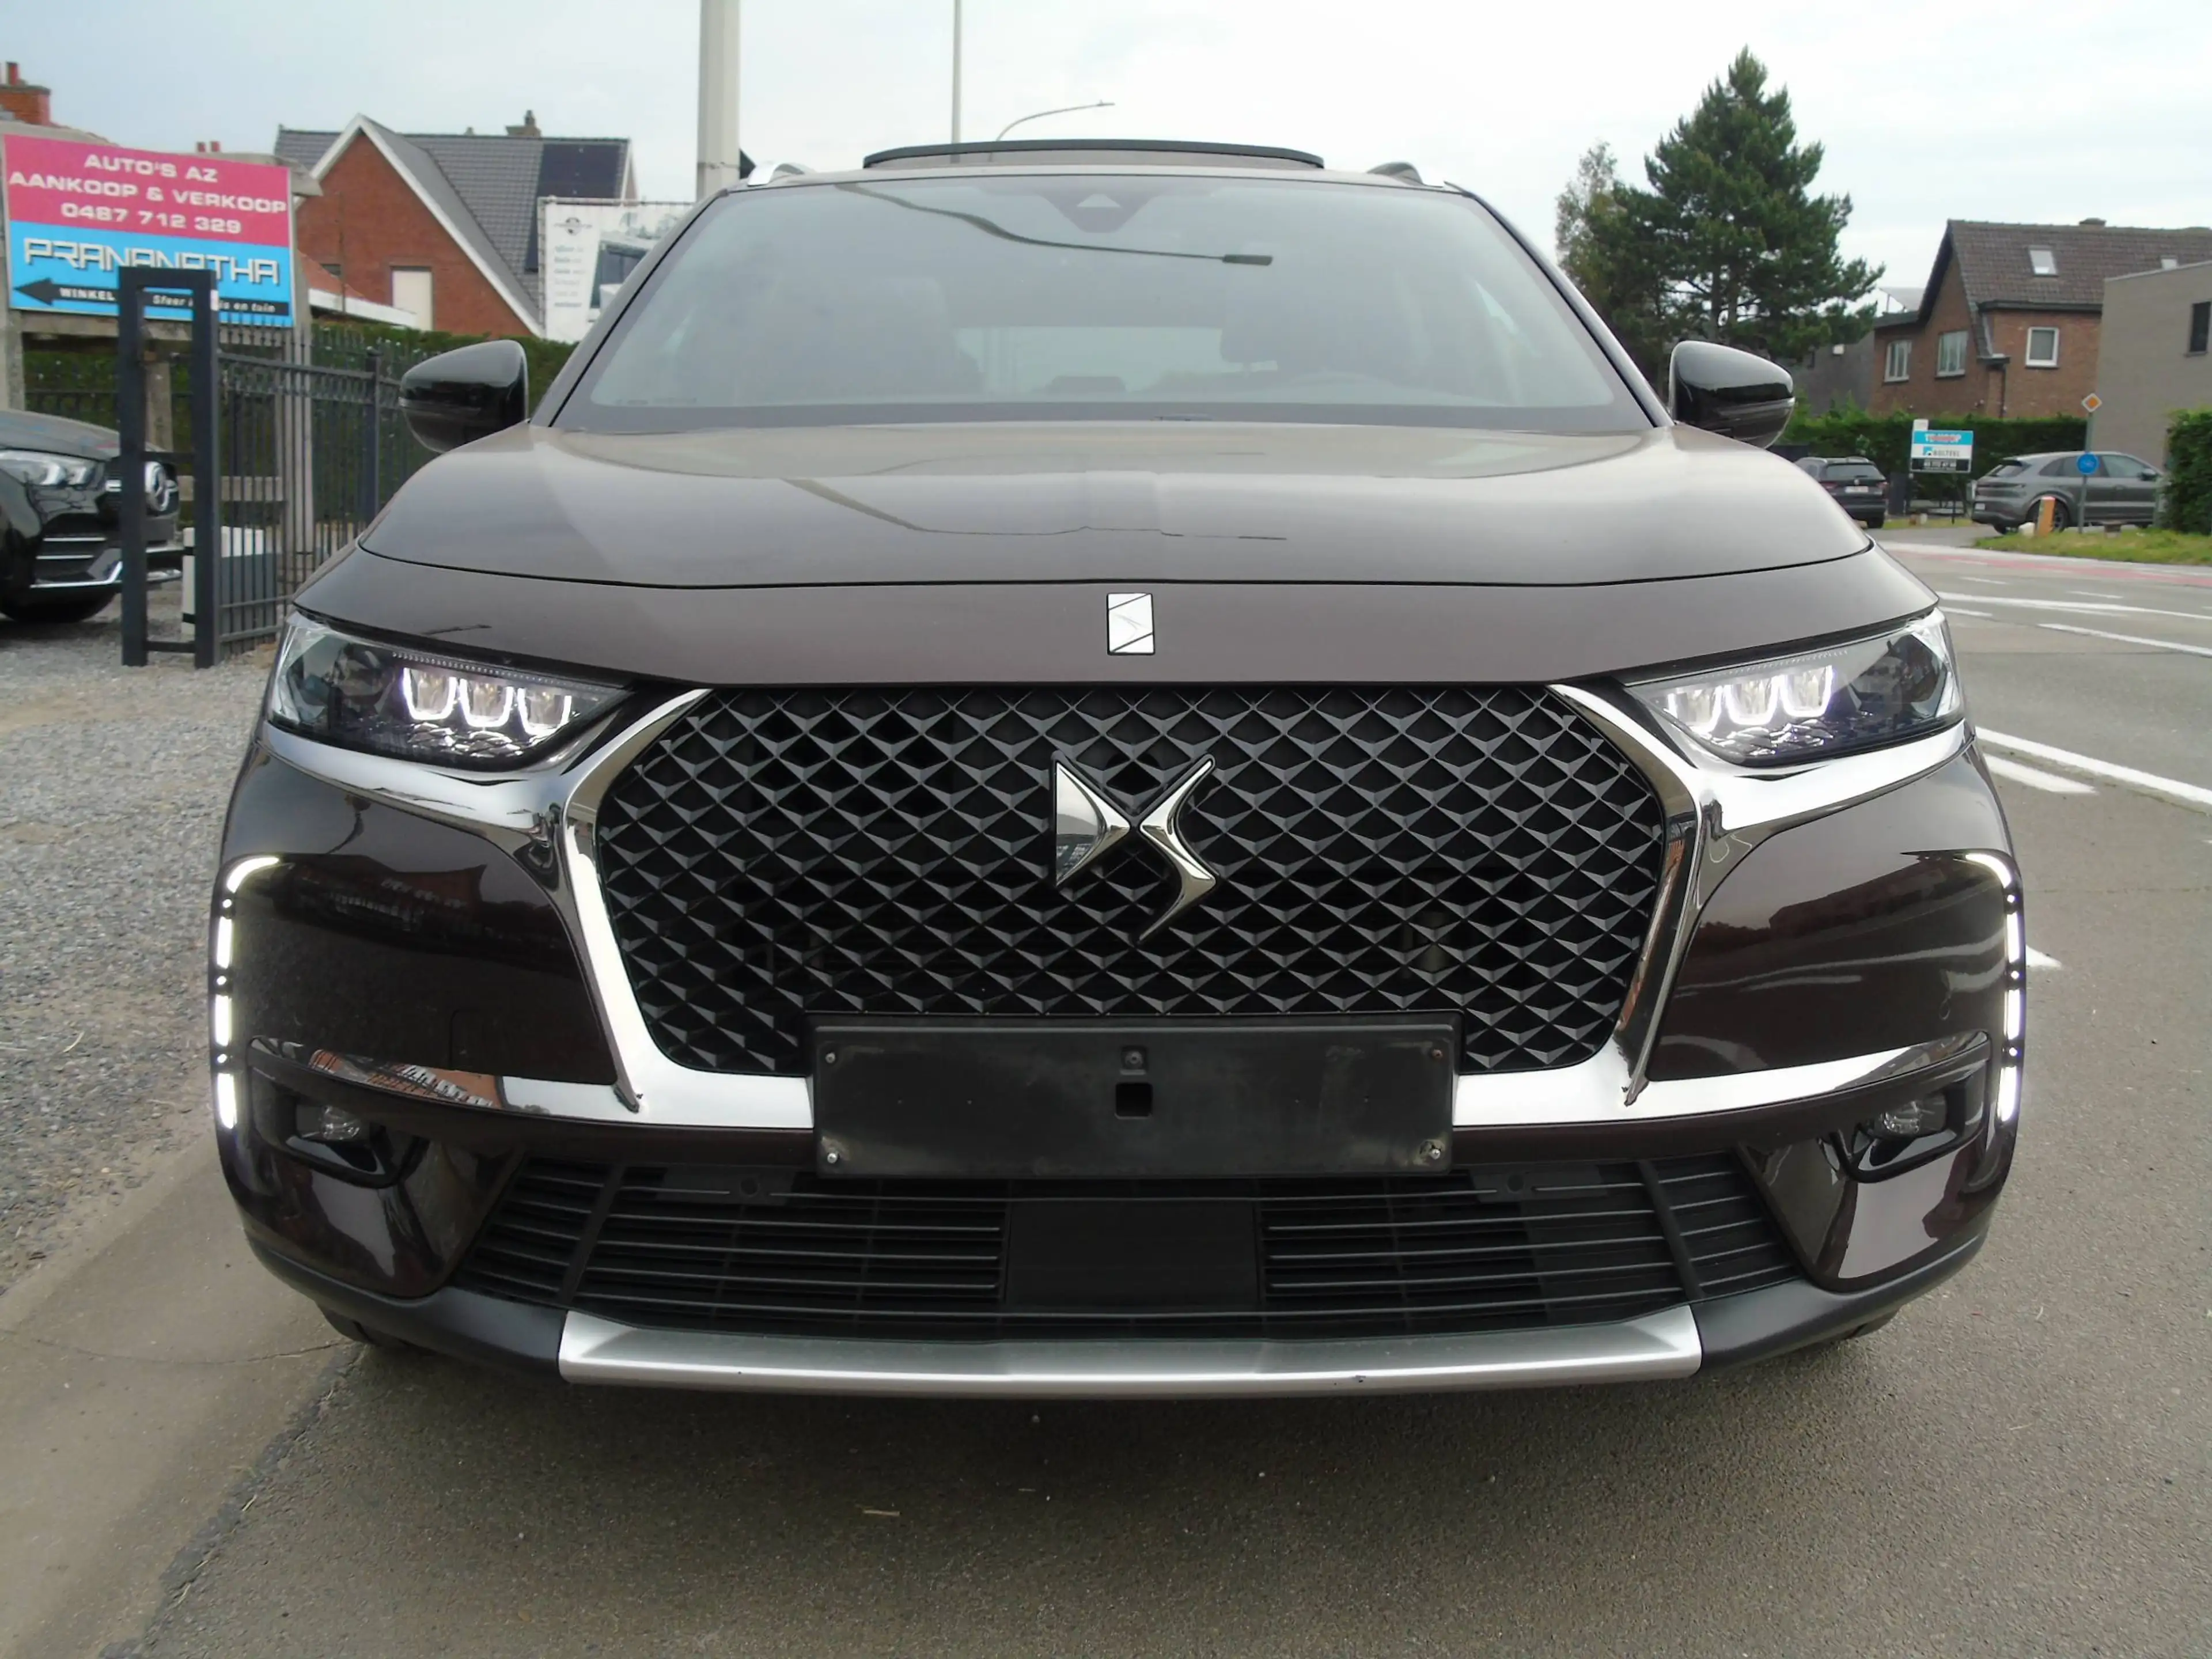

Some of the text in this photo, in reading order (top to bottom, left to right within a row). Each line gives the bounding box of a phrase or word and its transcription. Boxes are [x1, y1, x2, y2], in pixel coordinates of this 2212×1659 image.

[85, 154, 218, 183] AUTO'S AZ
[9, 171, 287, 214] AANKOOP & VERKOOP
[60, 202, 242, 234] 0487 712 329
[59, 287, 116, 301] WINKEL
[152, 294, 185, 306] Sfeer
[233, 302, 248, 310] en
[251, 303, 275, 313] tuin
